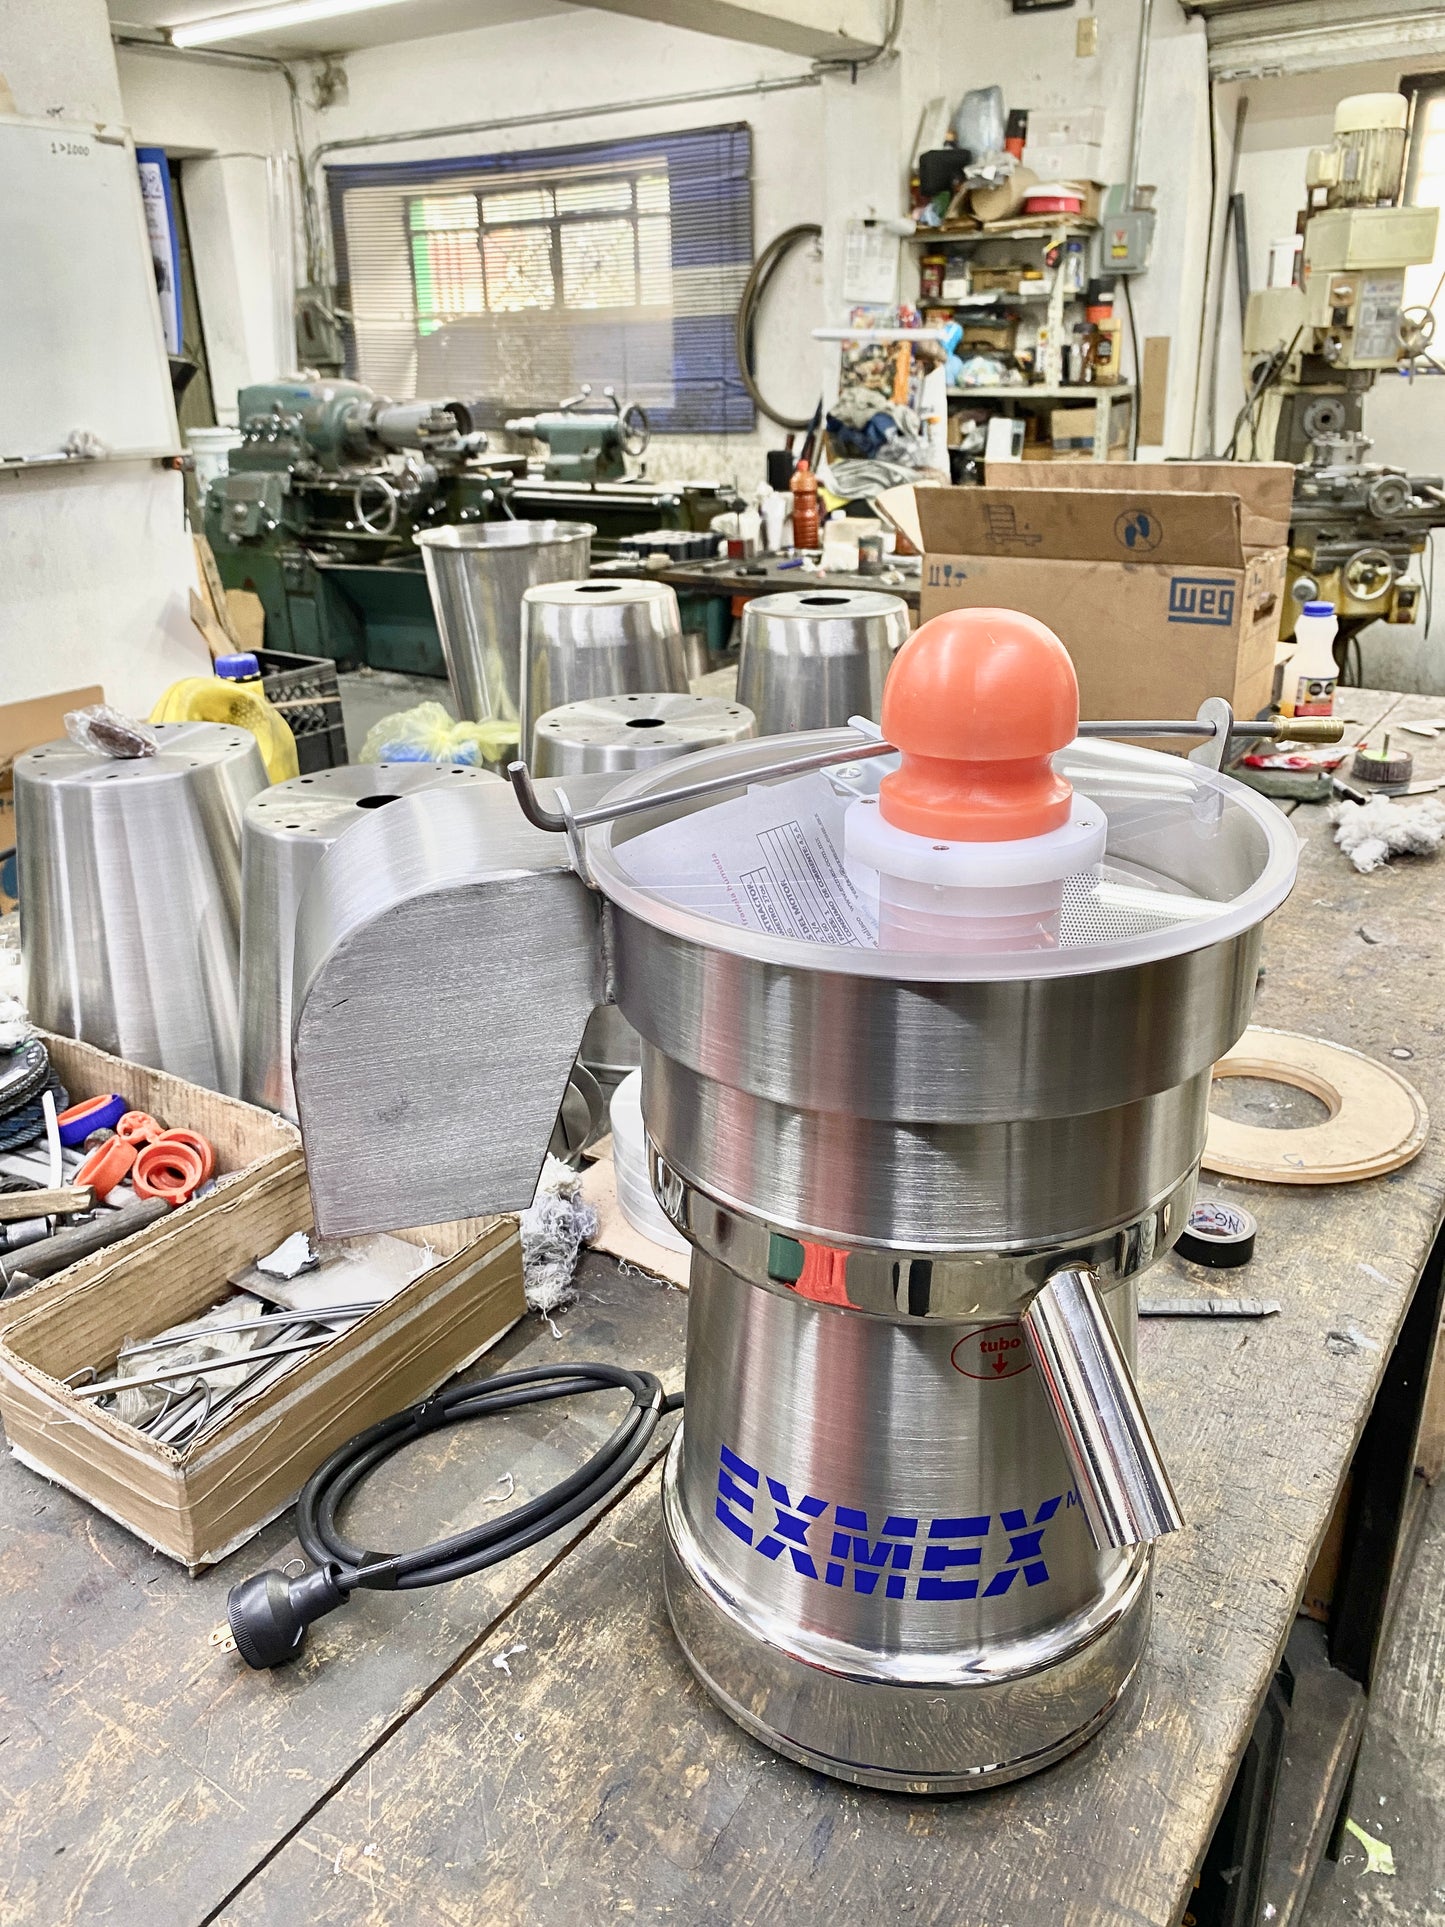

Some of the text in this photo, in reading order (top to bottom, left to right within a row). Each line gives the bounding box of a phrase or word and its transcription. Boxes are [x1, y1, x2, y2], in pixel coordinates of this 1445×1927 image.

[802, 846, 824, 887] CORRIENTE:
[821, 891, 830, 899] DE
[797, 915, 809, 934] DEL
[811, 922, 820, 934] 1/4
[829, 901, 852, 937] CONSUMO
[856, 916, 873, 941] Jalisco
[979, 1336, 1021, 1353] tubo
[716, 1444, 1063, 1600] EXMEX
